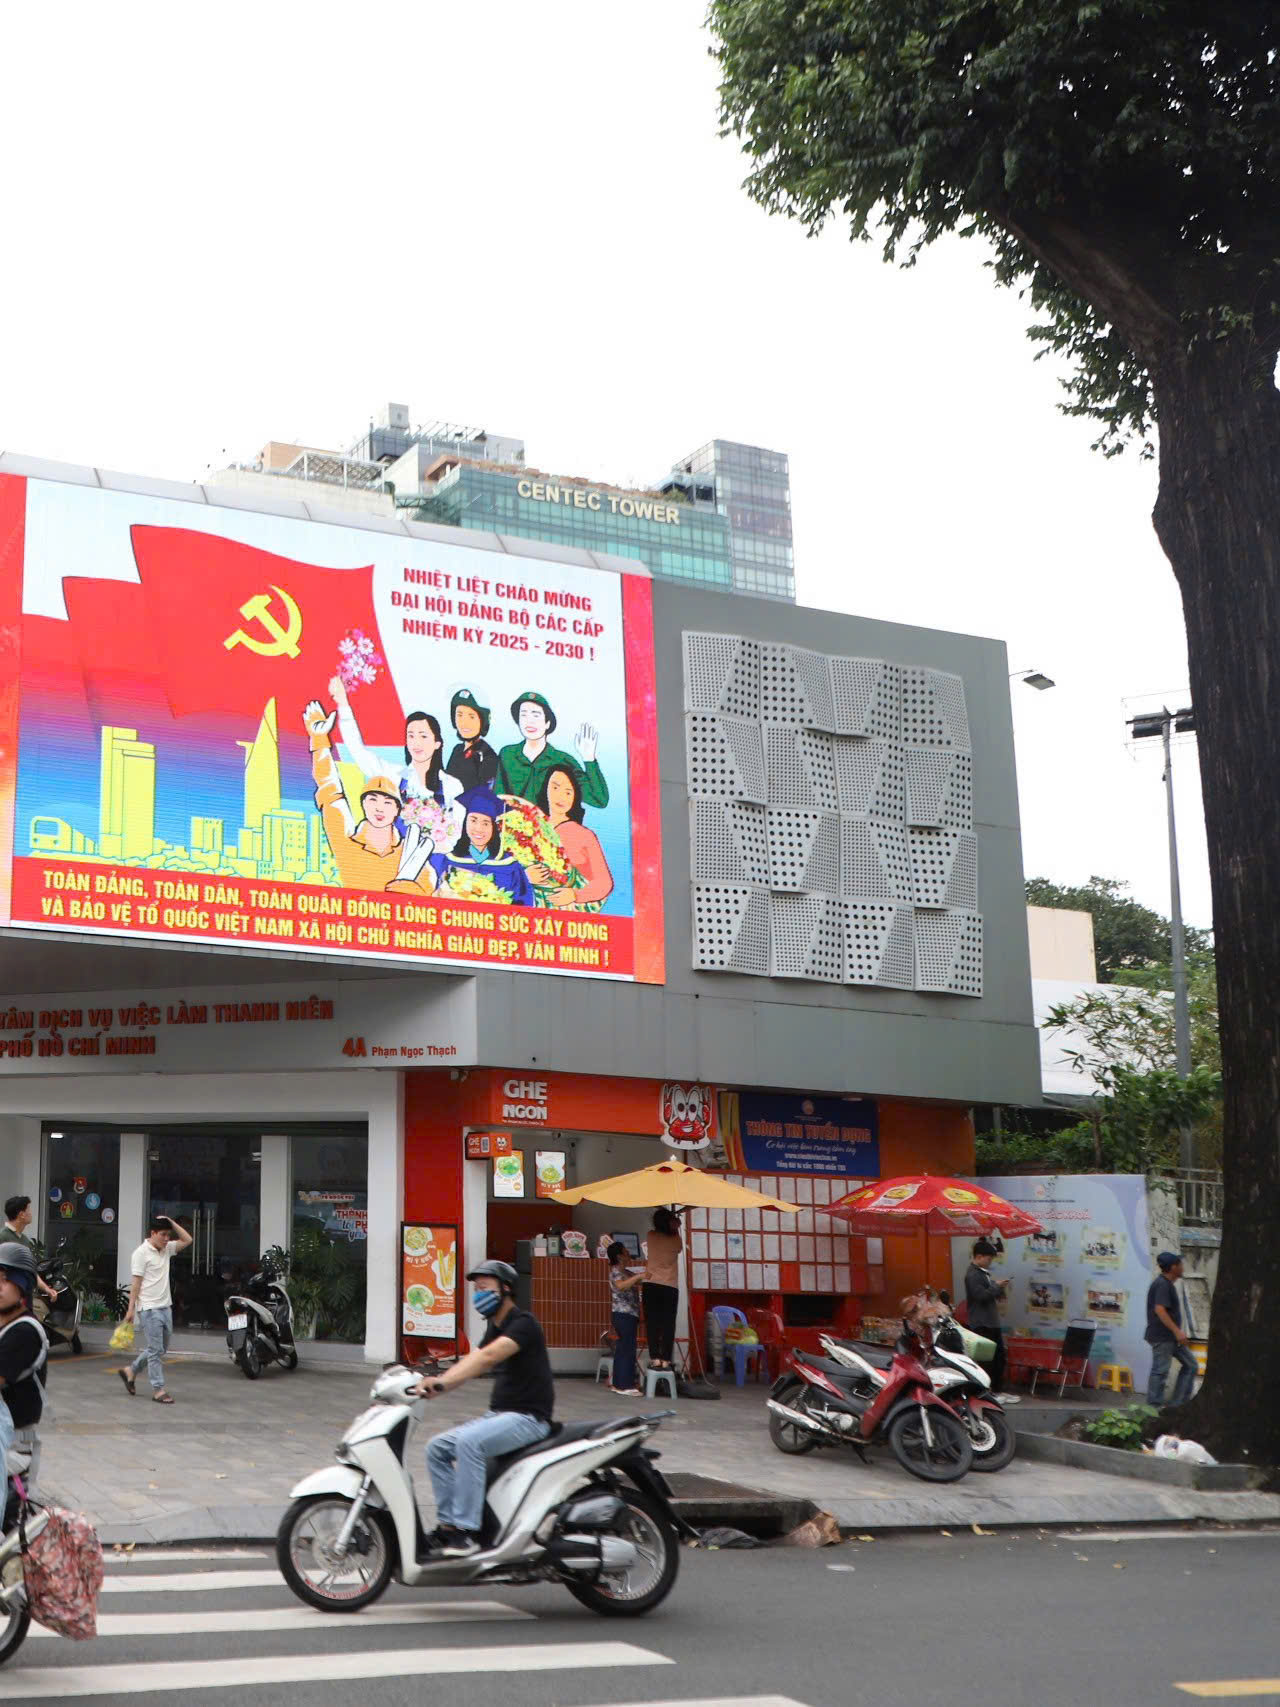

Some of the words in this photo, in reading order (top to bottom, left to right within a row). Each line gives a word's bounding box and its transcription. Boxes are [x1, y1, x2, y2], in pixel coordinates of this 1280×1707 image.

[518, 480, 600, 510] CENTEC
[608, 496, 680, 524] TOWER
[404, 567, 452, 591] NHIỆT
[457, 575, 490, 597] LIỆT
[495, 581, 539, 603] CHÀO
[544, 588, 592, 612] MỪNG
[391, 591, 419, 612] ĐẠI
[425, 595, 452, 617] HỘI
[458, 600, 503, 622] ĐẢNG
[509, 608, 530, 630] BỘ
[536, 612, 567, 632] CÁC
[573, 616, 604, 638] CẤP
[402, 618, 457, 641] NHIỆM
[463, 625, 483, 644] KỲ
[489, 632, 529, 651] 2025
[545, 641, 584, 660] 2030
[590, 647, 595, 661] !
[43, 868, 90, 892] TOÀN
[95, 870, 149, 899] ĐẢNG,
[154, 879, 199, 902] TOÀN
[204, 883, 244, 908] DÂN,
[249, 887, 292, 911] TOÀN
[297, 891, 342, 915] QUÂN
[347, 895, 391, 921] ĐỒNG
[395, 902, 437, 925] LÒNG
[441, 910, 495, 931] CHUNG
[499, 912, 529, 934] SỨC
[534, 917, 563, 937] XÂY
[567, 922, 609, 943] DỰNG
[41, 897, 64, 917] VÀ
[69, 896, 105, 920] BẢO
[111, 901, 132, 927] VỆ
[137, 900, 160, 925] TỔ
[163, 907, 209, 930] QUỐC
[214, 911, 249, 936] VIỆT
[254, 916, 293, 937] NAM
[298, 917, 320, 940] XÃ
[325, 922, 353, 945] HỘI
[357, 923, 389, 946] CHỦ
[394, 928, 443, 951] NGHĨA
[447, 935, 484, 956] GIÀU
[488, 939, 520, 961] ĐẸP,
[524, 938, 556, 962] VĂN
[559, 946, 600, 966] MINH
[604, 950, 609, 966] !
[39, 1009, 82, 1033] DỊCH
[88, 1008, 113, 1031] VỤ
[118, 1002, 160, 1031] VIỆC
[166, 1000, 207, 1025] LÀM
[213, 1002, 280, 1024] THANH
[286, 994, 335, 1021] NIÊN
[38, 1031, 63, 1057] HỒ
[68, 1032, 102, 1056] CHÍ
[105, 1035, 156, 1056] MINH
[342, 1037, 367, 1058] 4A
[371, 1046, 398, 1058] Phạm
[400, 1046, 424, 1059] Ngọc
[426, 1045, 457, 1057] Thạch
[502, 1104, 548, 1120] NGON
[504, 1080, 548, 1105] GHẸ
[745, 1119, 783, 1136] THÔNG
[784, 1123, 803, 1138] TIN
[804, 1121, 840, 1140] TUYỂN
[841, 1127, 872, 1144] DỤNG
[355, 1221, 368, 1229] PH
